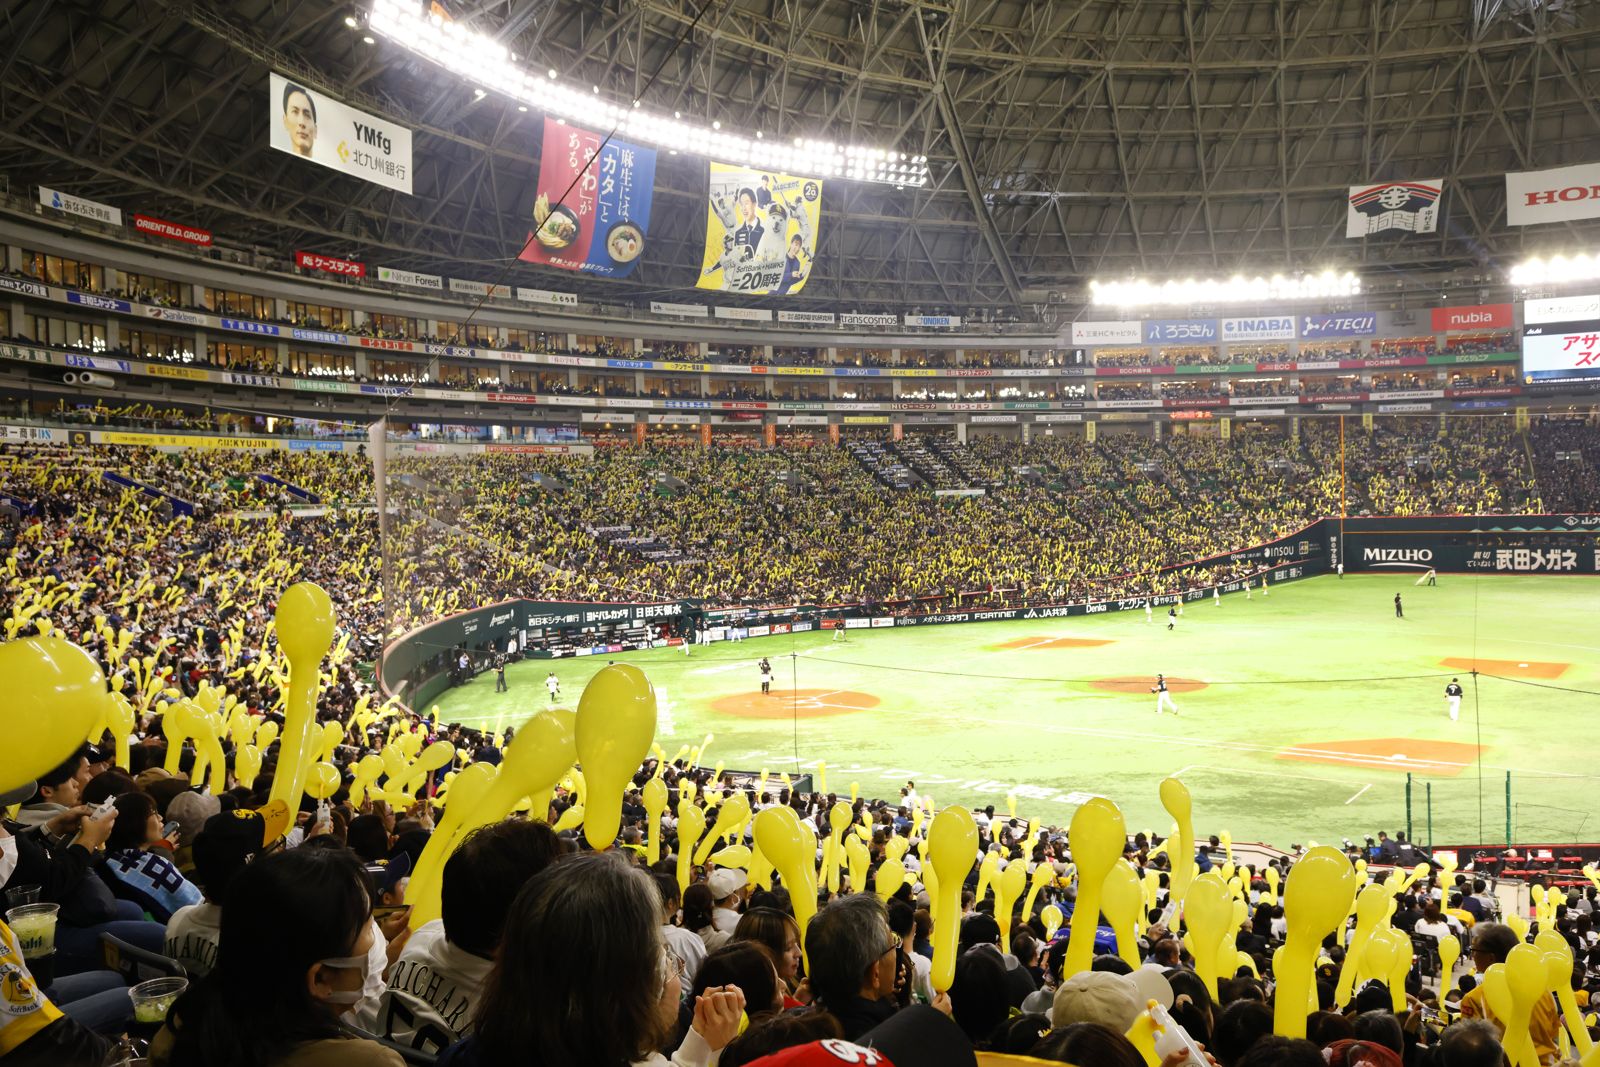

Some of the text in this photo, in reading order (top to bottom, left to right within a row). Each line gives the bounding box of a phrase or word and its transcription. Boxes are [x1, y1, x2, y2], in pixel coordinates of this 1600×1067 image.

[353, 121, 391, 155] YMfg
[569, 133, 580, 176] ある。
[353, 149, 406, 180] 北九州銀行
[599, 143, 620, 223] 「カタ」と
[618, 149, 634, 223] 麻生には、
[64, 199, 111, 221] あなぶき興産
[136, 218, 210, 243] ORIENT BLD. GROUP
[314, 257, 360, 275] ケーズデンキ
[392, 271, 440, 288] Nihon Forest
[79, 295, 119, 310] 三和シャッター
[841, 315, 897, 326] transcosmos
[1238, 318, 1293, 332] INABA
[1451, 311, 1492, 325] nubia
[1087, 330, 1137, 338] 三菱HCキャピタル
[1165, 323, 1215, 339] ろうきん
[429, 345, 447, 355] SCSK
[453, 348, 471, 357] SCSK
[1274, 363, 1290, 371] ECC
[375, 387, 398, 395] TOTO
[1363, 548, 1433, 561] MIZUHO
[1496, 549, 1577, 571] 武田メガネ
[586, 609, 629, 622] ヨドバシカメラ
[636, 604, 682, 619] 日田天領水
[974, 611, 1017, 620] FORTINET
[1039, 607, 1068, 618] JA共済
[1086, 604, 1107, 613] Denka
[528, 614, 579, 627] 西日本シティ銀行
[922, 613, 969, 623] メガネのヨネザワ
